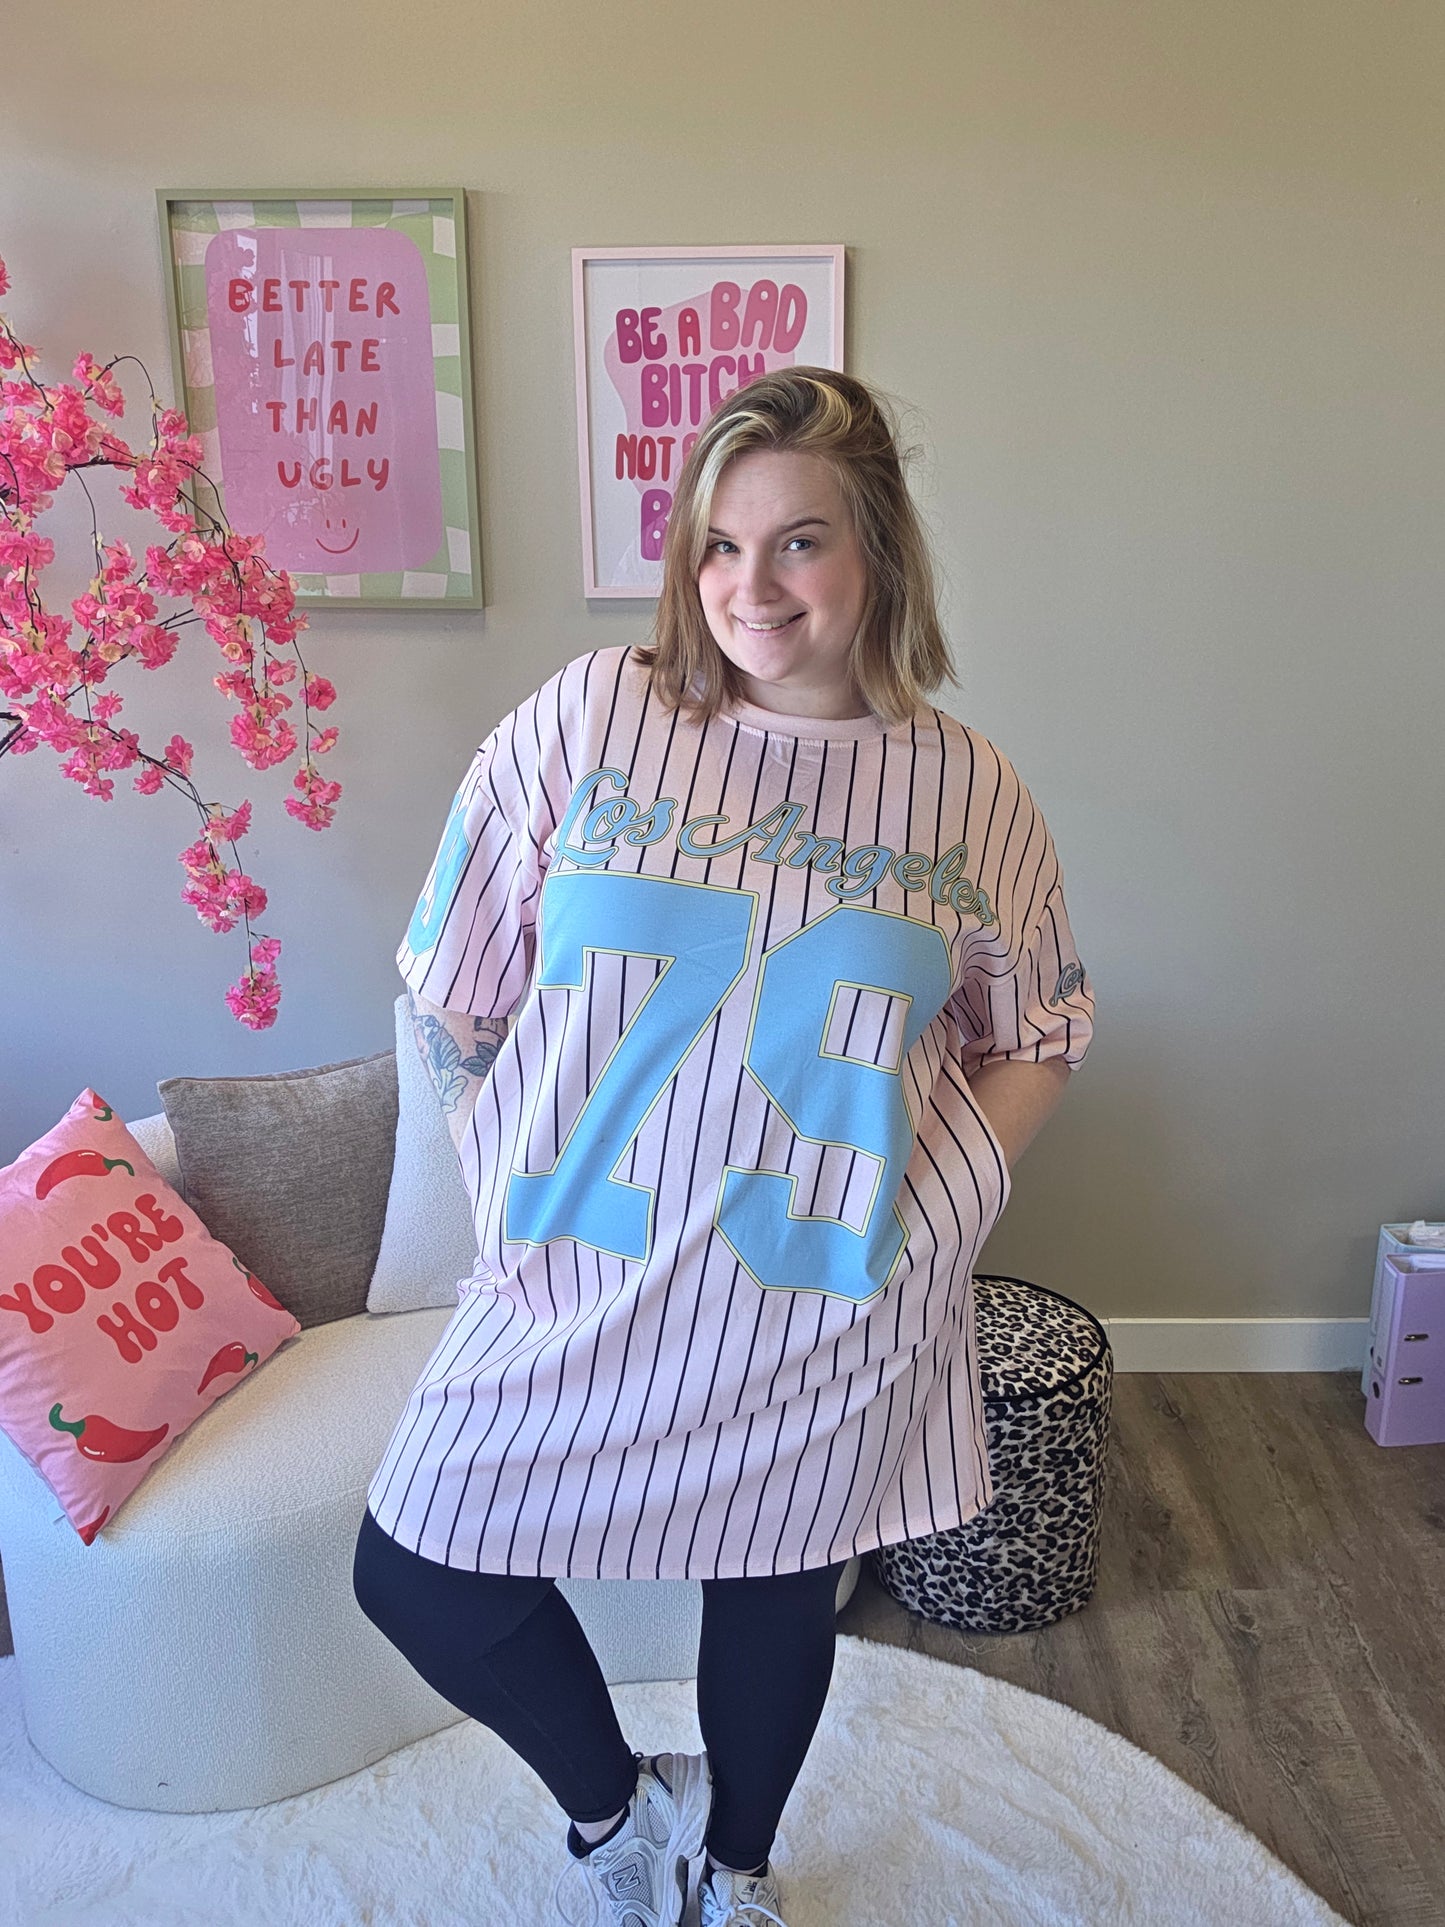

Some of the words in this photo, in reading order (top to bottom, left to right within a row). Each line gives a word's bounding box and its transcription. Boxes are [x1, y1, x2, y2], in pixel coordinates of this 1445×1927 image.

[228, 278, 401, 318] BETTER
[615, 307, 668, 364] BE
[678, 307, 701, 357] A
[709, 279, 808, 354] BAD
[274, 339, 382, 376] LATE
[266, 398, 379, 438] THAN
[277, 457, 390, 492] UGLY
[615, 433, 676, 482] NOT
[548, 767, 679, 870] Los
[676, 800, 995, 926] Angeles
[502, 870, 955, 1305] 79
[0, 1193, 184, 1334] YOU'RE
[97, 1256, 204, 1364] HOT
[612, 1863, 641, 1894] N
